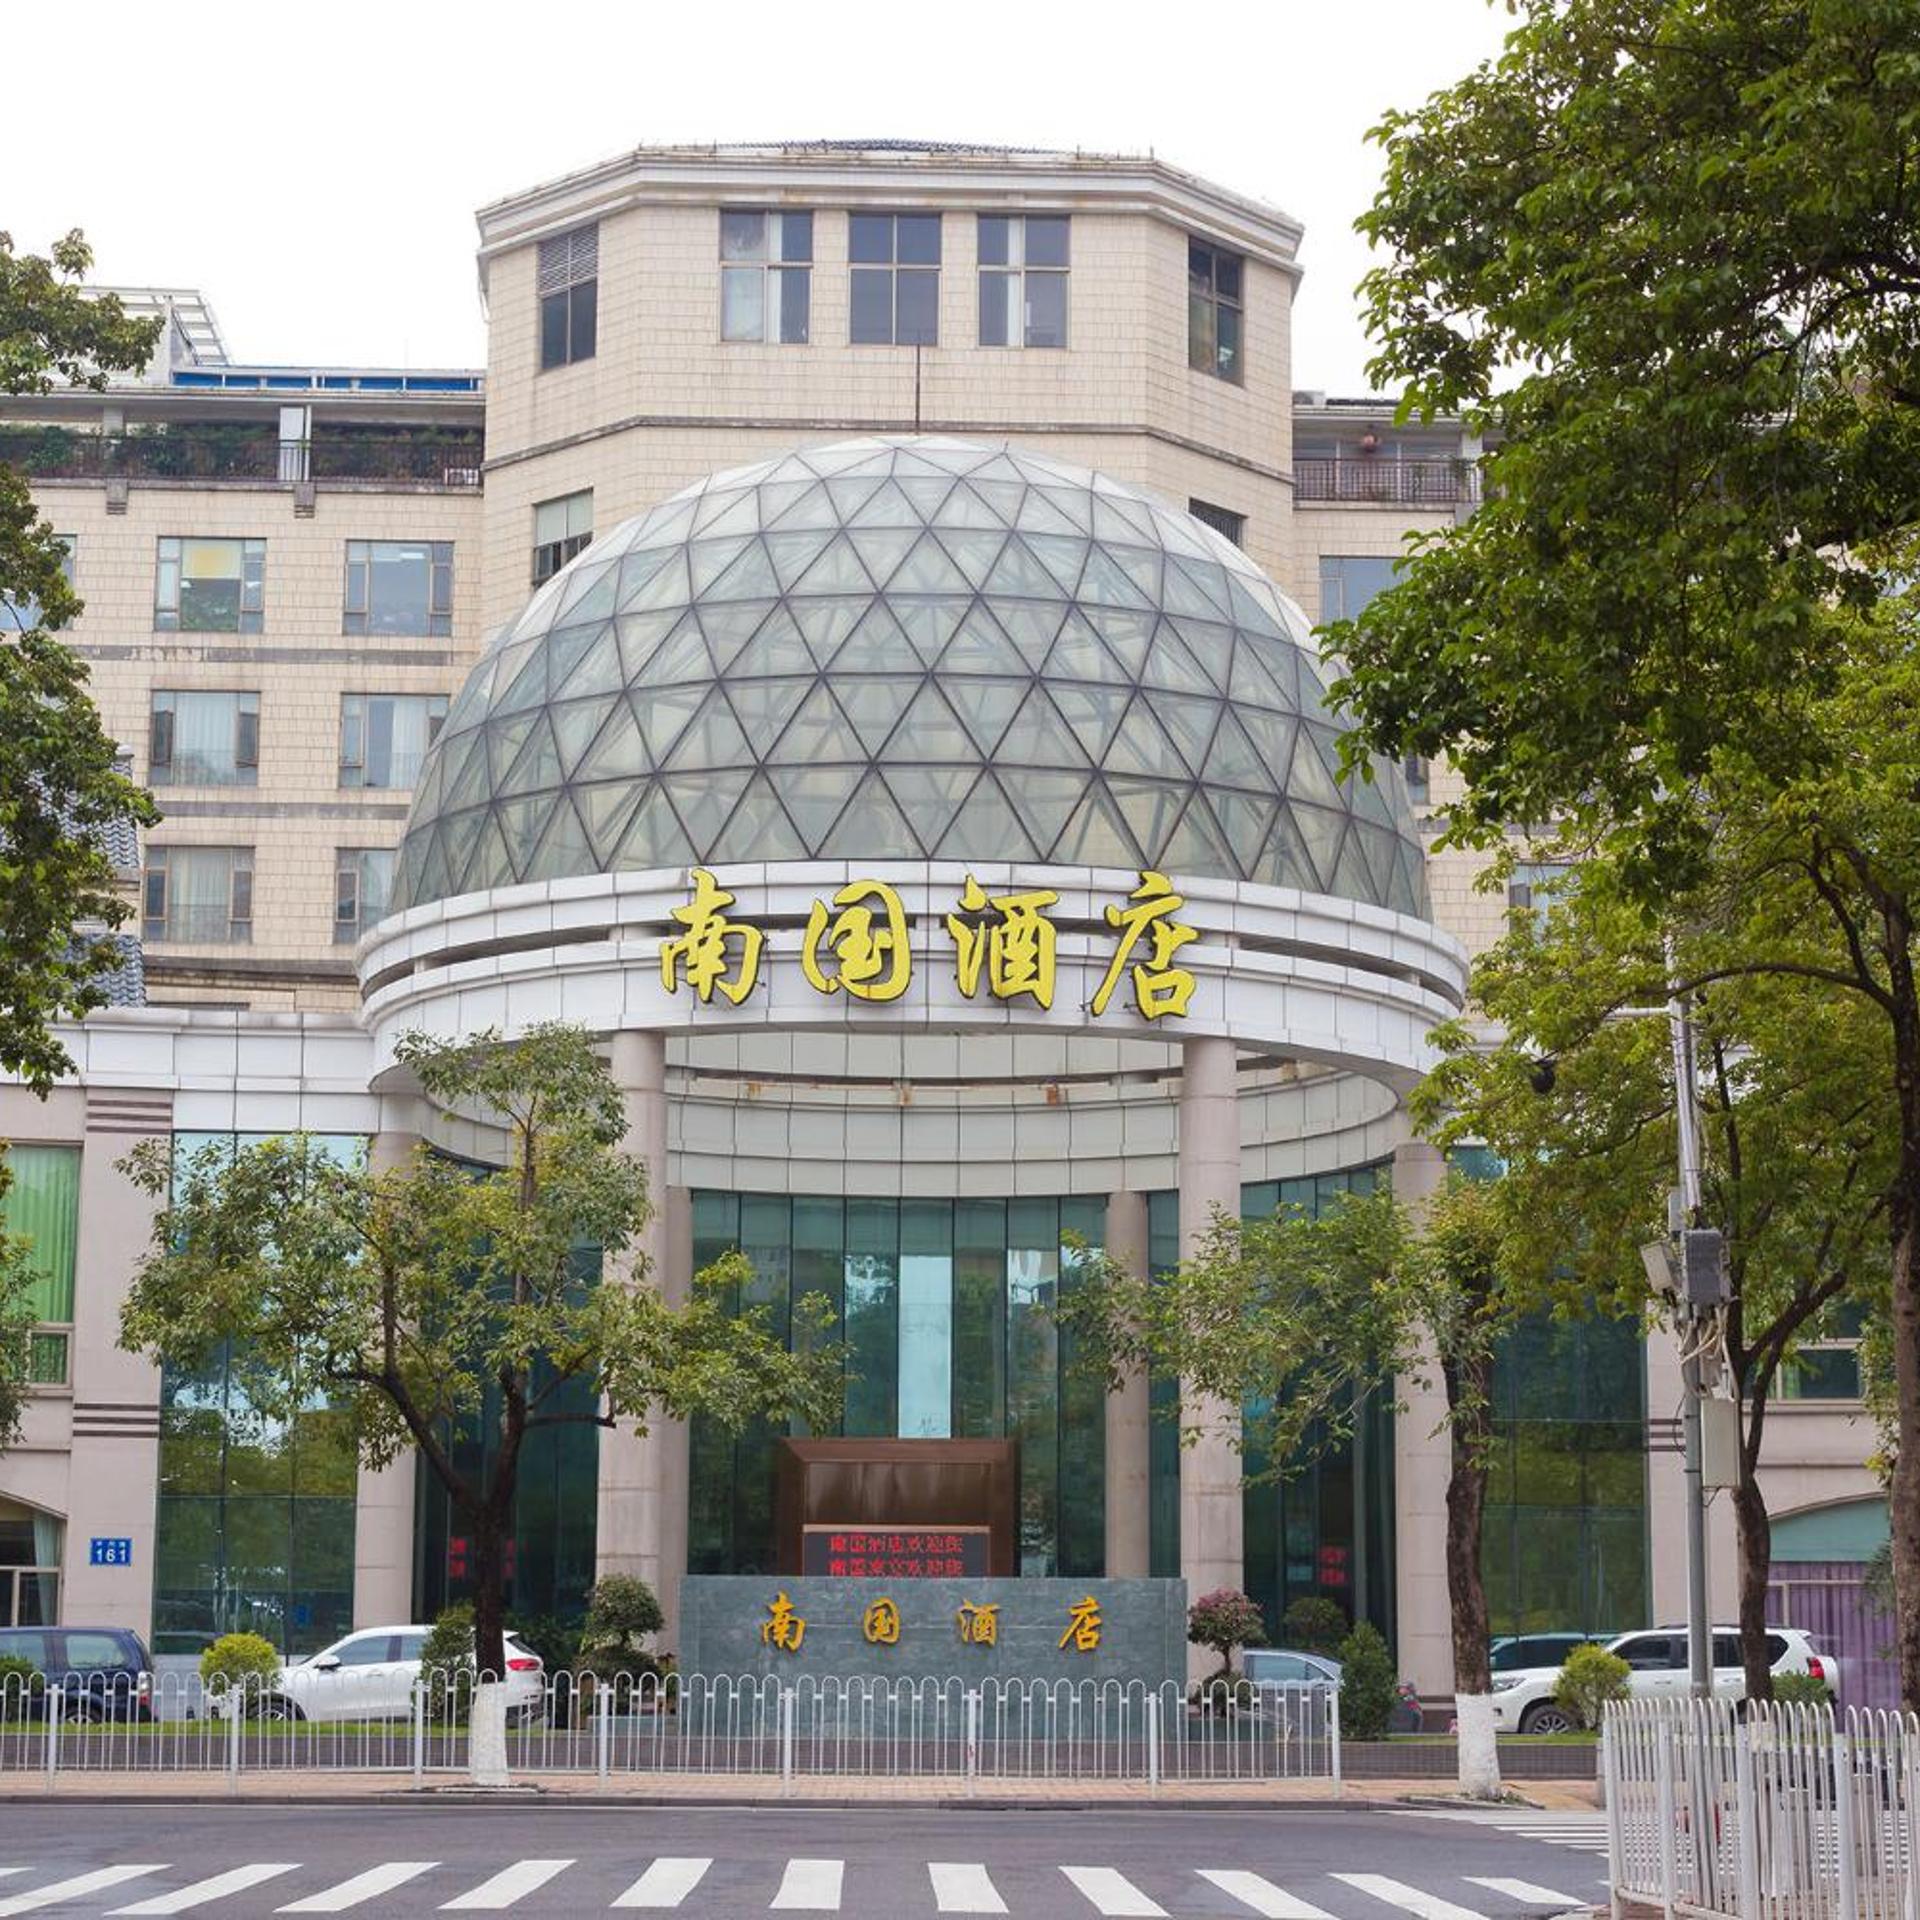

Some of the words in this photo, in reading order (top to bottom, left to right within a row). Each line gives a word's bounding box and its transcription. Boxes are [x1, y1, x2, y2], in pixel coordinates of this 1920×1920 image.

[660, 867, 1201, 1020] 南国酒店
[96, 1548, 127, 1562] 161
[762, 1591, 1104, 1652] 南国酒店
